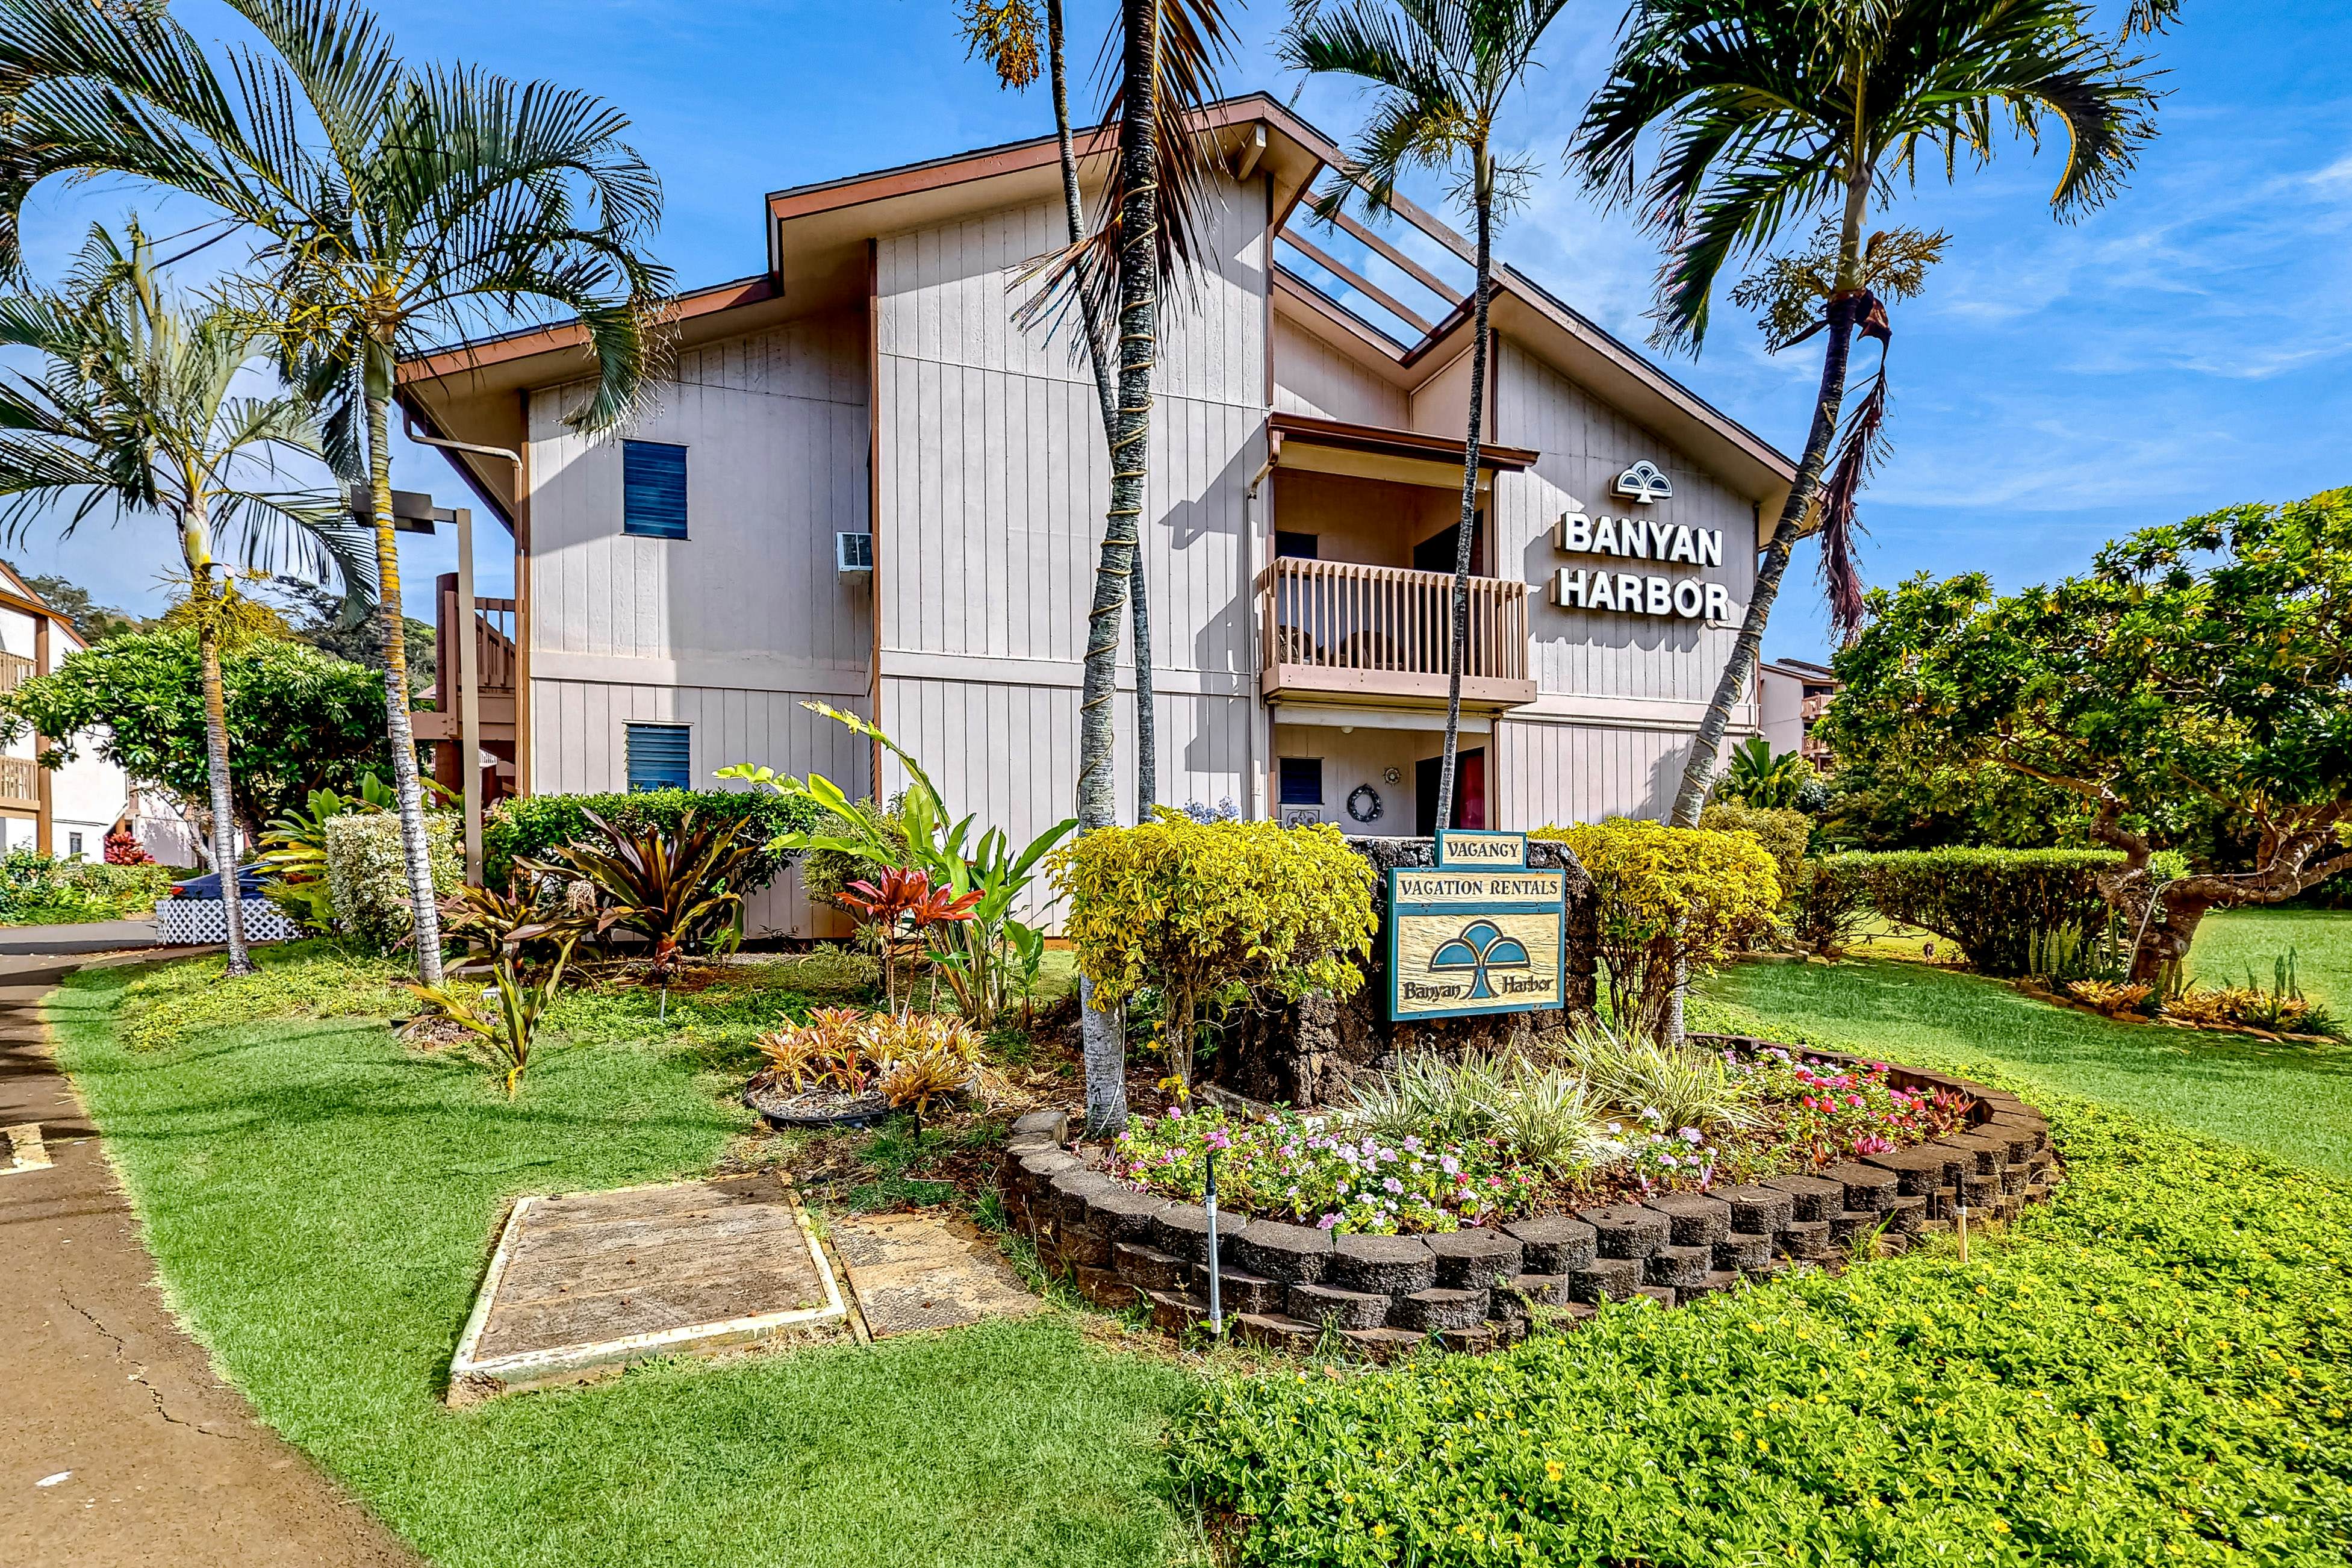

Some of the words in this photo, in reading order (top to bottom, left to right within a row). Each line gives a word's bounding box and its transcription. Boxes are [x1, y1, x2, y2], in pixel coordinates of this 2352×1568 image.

[1563, 511, 1723, 567] BANYAN
[1558, 567, 1730, 621] HARBOR
[1446, 841, 1519, 857] VACANCY
[1400, 880, 1483, 896] VACATION
[1490, 880, 1558, 895] RENTALS
[1402, 981, 1461, 1003] Banyan
[1501, 975, 1554, 994] Harbor
